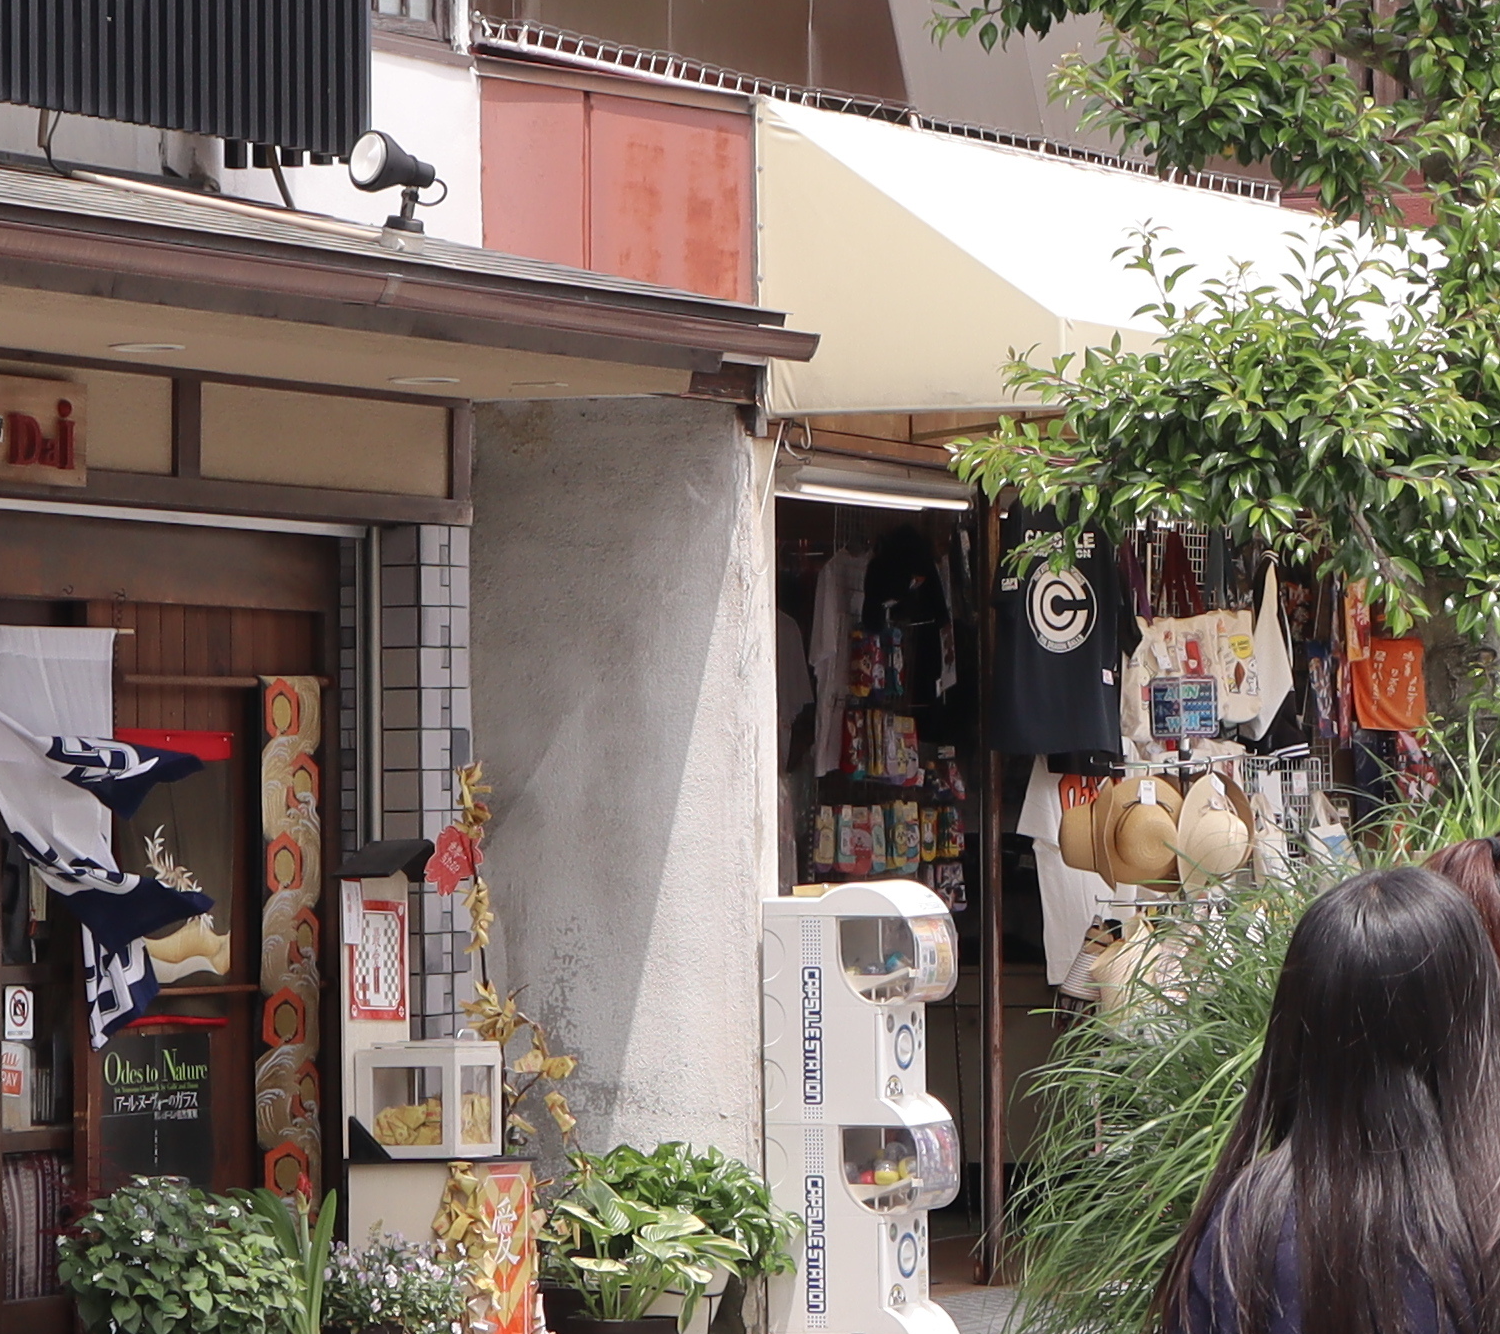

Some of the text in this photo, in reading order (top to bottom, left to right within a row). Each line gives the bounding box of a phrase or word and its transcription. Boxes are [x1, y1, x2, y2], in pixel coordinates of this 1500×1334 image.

[104, 1048, 208, 1086] Odes to Nature
